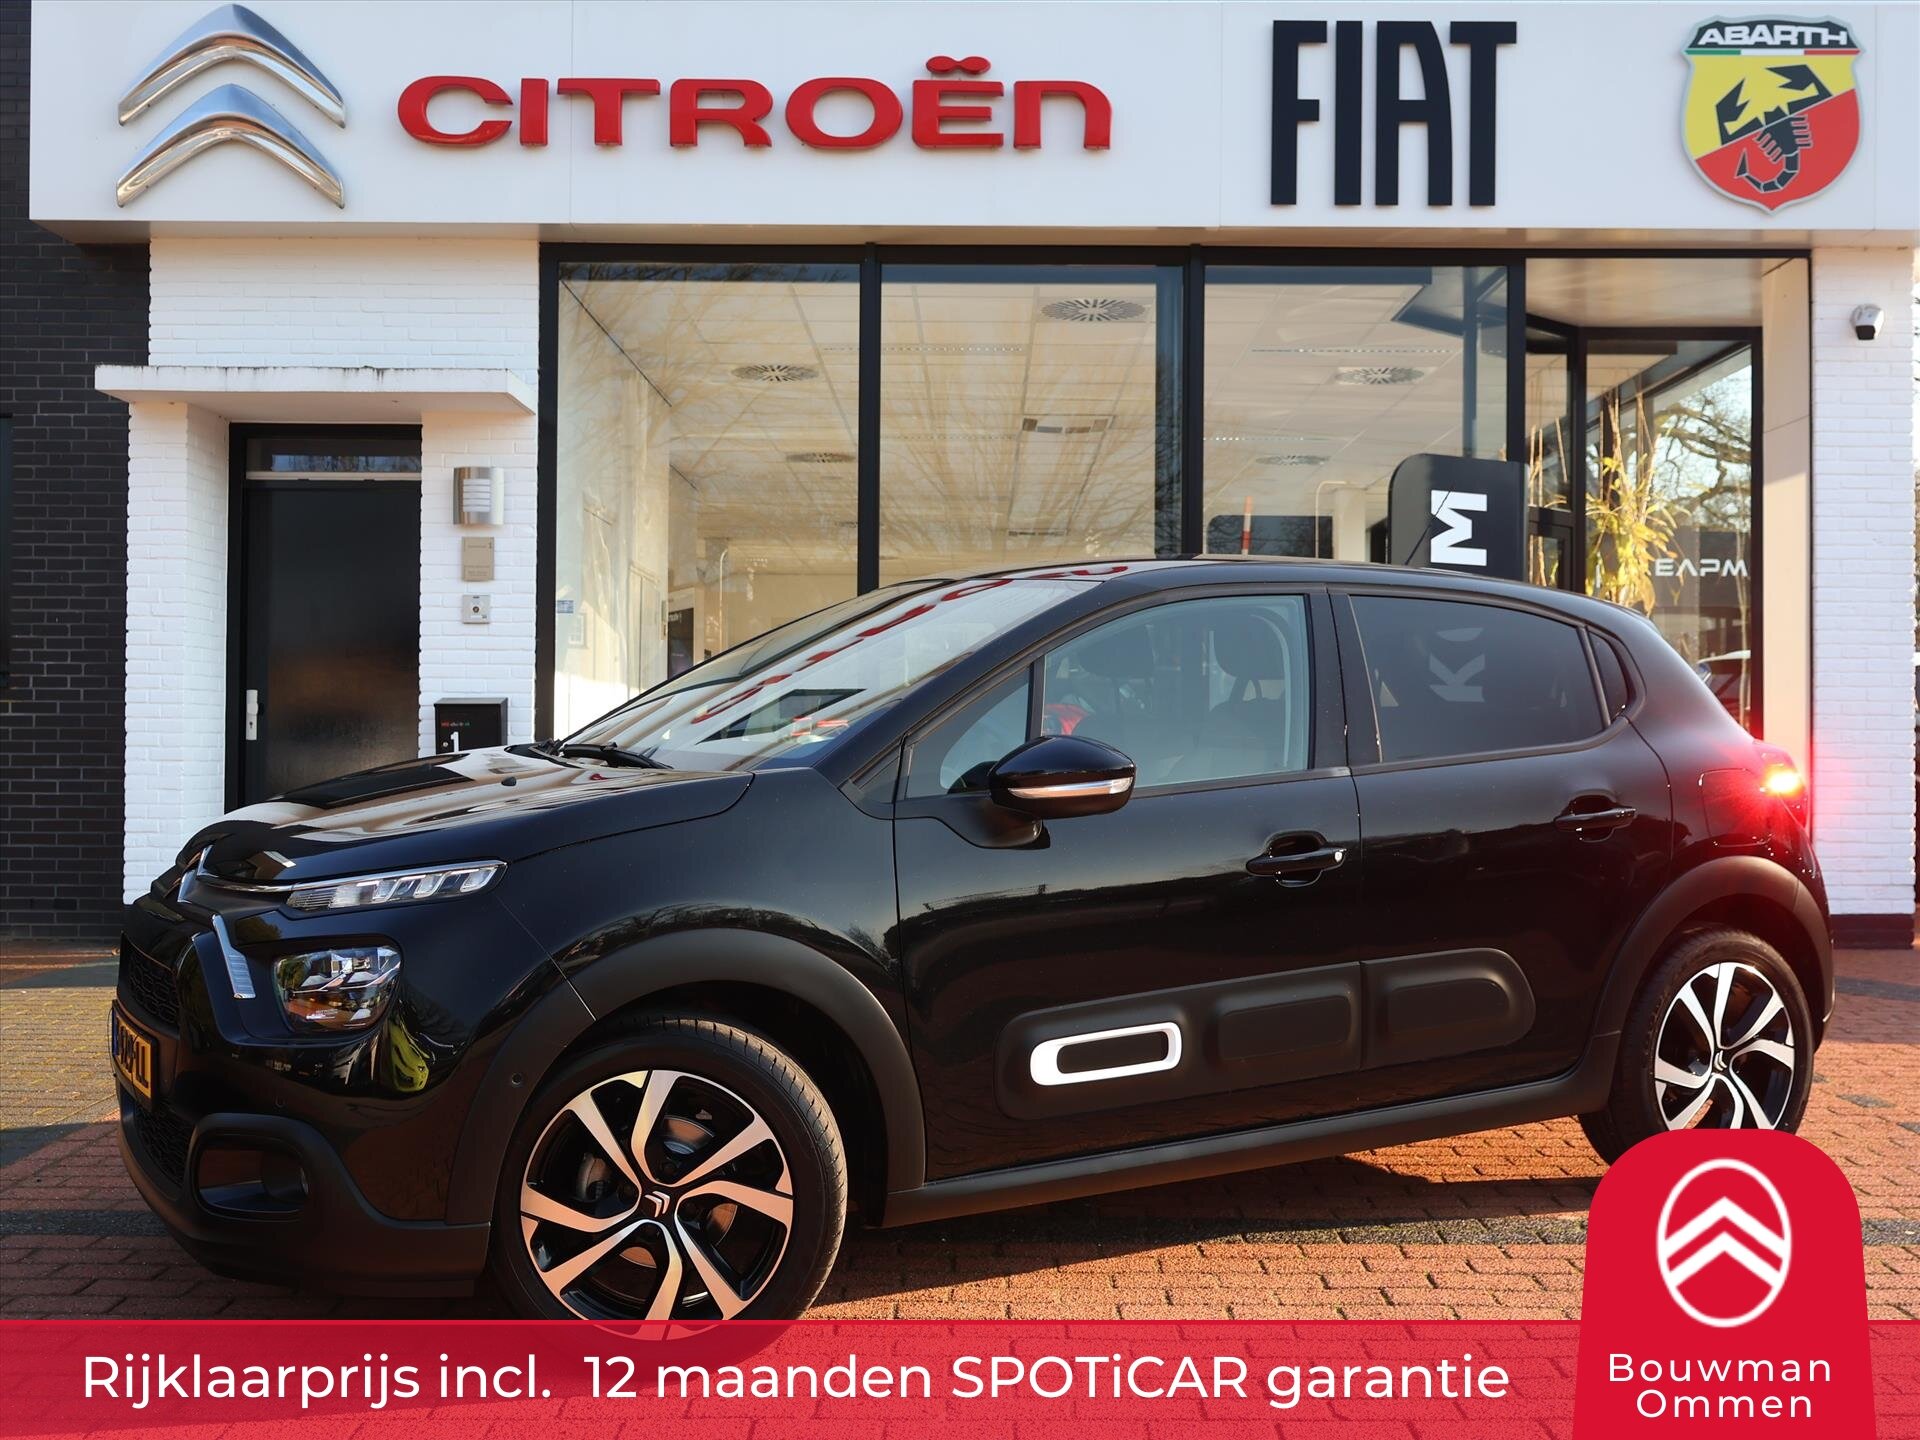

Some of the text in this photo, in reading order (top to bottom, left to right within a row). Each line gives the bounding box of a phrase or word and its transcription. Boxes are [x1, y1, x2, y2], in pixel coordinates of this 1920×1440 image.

[1697, 24, 1848, 46] ABARTH
[397, 56, 1113, 150] CITROËN
[1270, 20, 1518, 207] FIAT
[450, 731, 460, 753] 1
